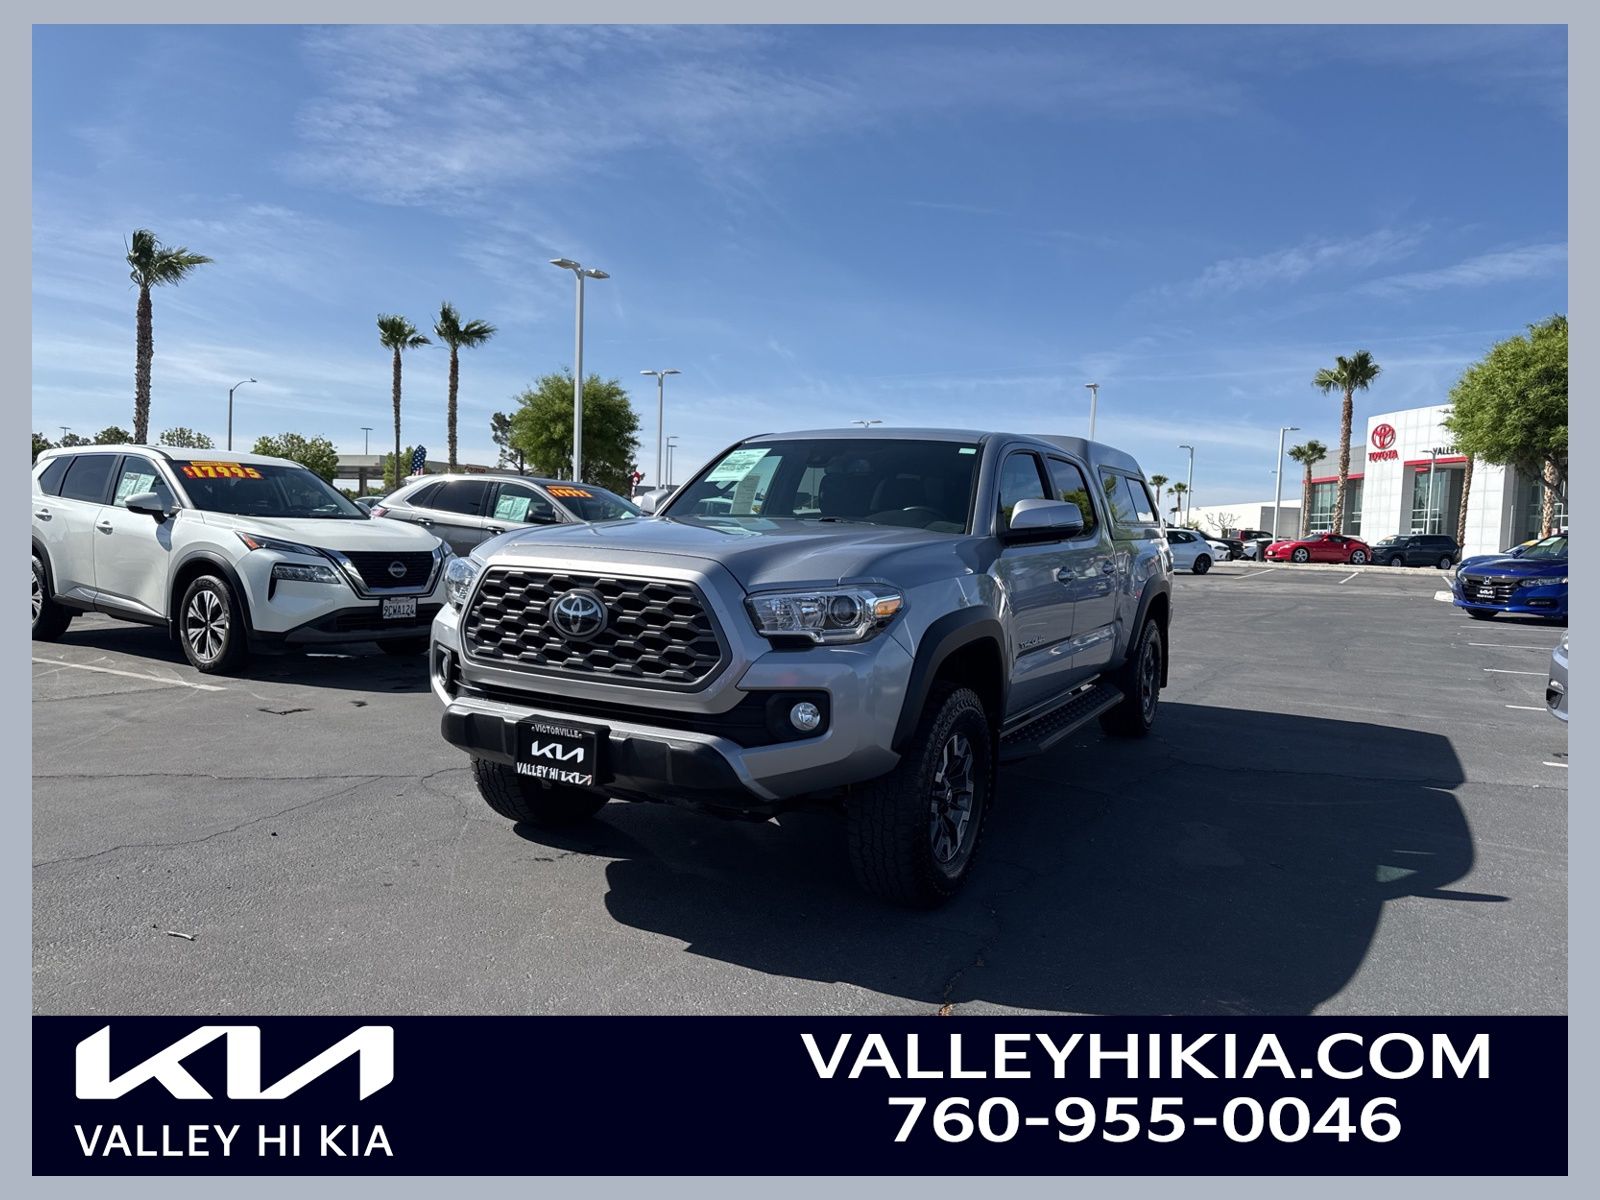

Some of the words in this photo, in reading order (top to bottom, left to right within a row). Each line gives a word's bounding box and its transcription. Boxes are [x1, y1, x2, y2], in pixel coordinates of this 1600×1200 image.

[1368, 449, 1399, 463] TOYOTA
[534, 723, 579, 738] VICTORVILLE
[531, 740, 584, 763] KIA
[516, 762, 549, 778] VALLEY
[549, 767, 559, 780] HI
[560, 770, 592, 786] KIA
